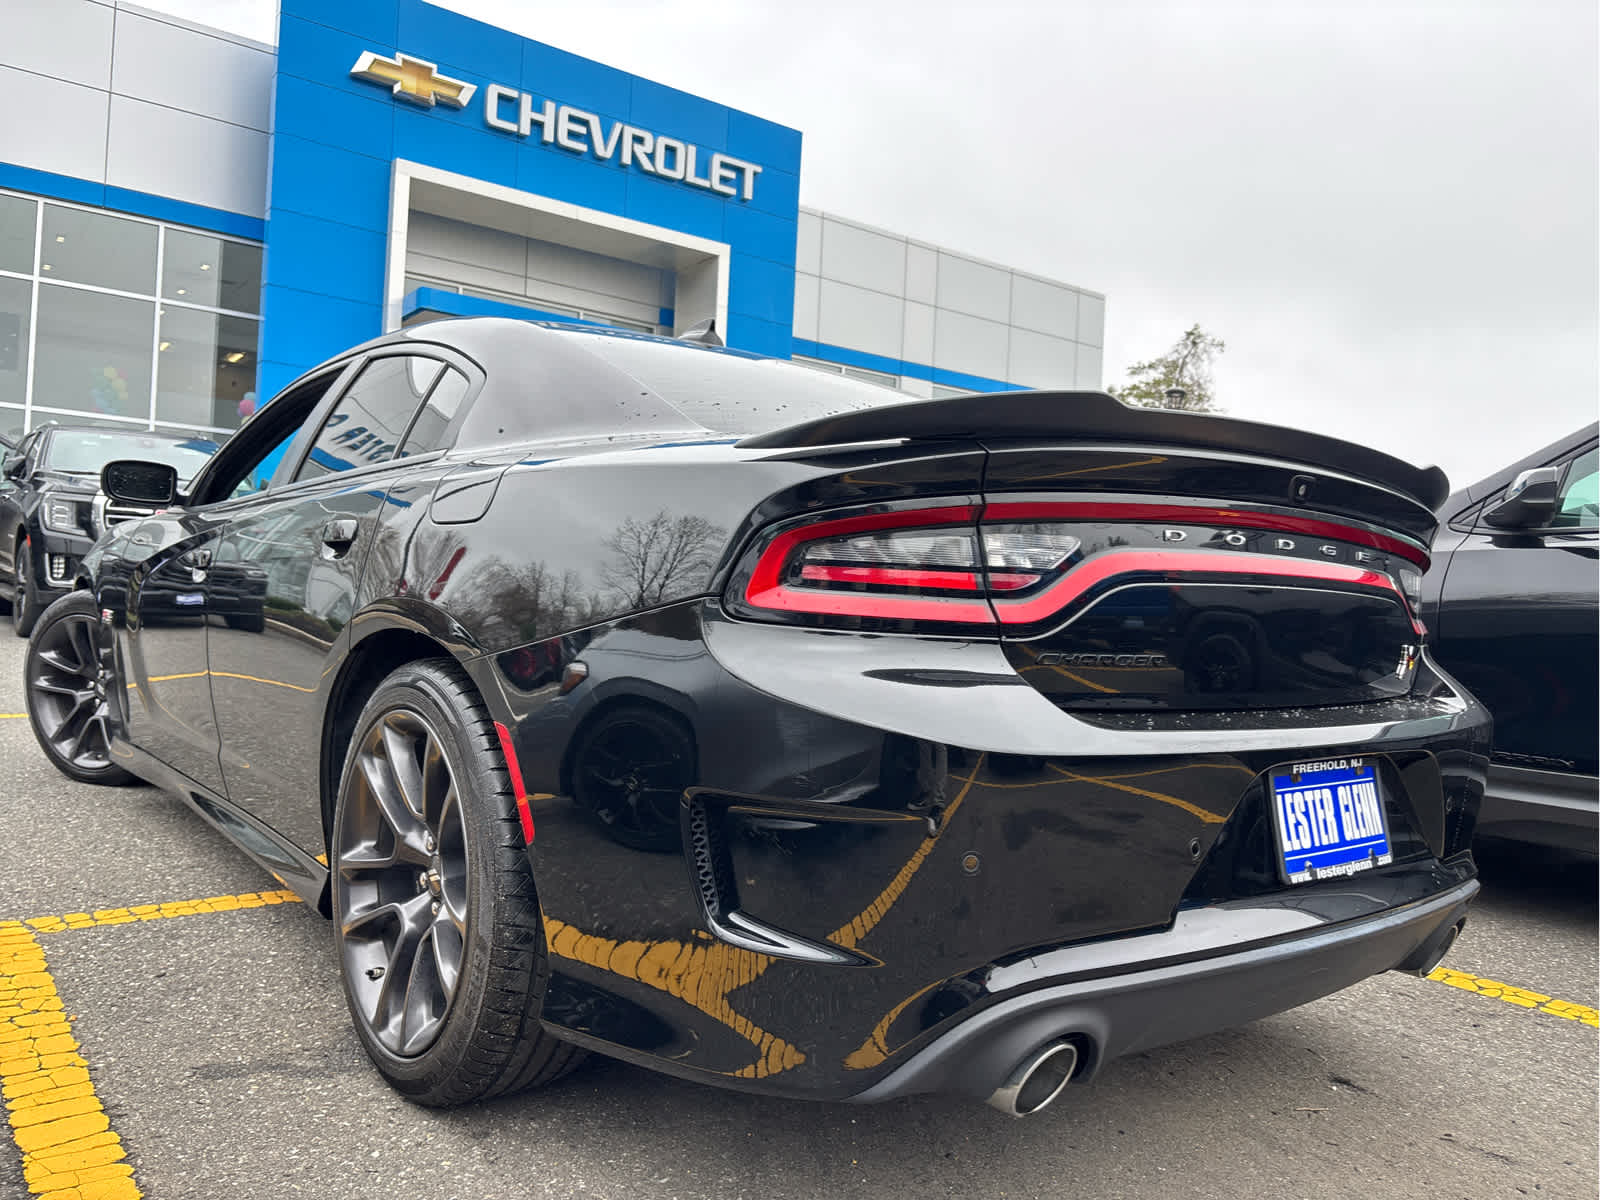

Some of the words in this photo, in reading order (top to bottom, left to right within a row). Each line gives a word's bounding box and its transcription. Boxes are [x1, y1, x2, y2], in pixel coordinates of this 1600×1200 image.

[485, 83, 763, 203] CHEVROLET
[1163, 529, 1372, 562] DODGE
[1035, 652, 1168, 667] CHARGER
[1292, 760, 1349, 774] FREEHOLD,
[1351, 758, 1363, 768] NJ
[1276, 788, 1339, 853] LESTER
[1337, 781, 1384, 841] GLENN
[1316, 860, 1373, 880] lesterglenn
